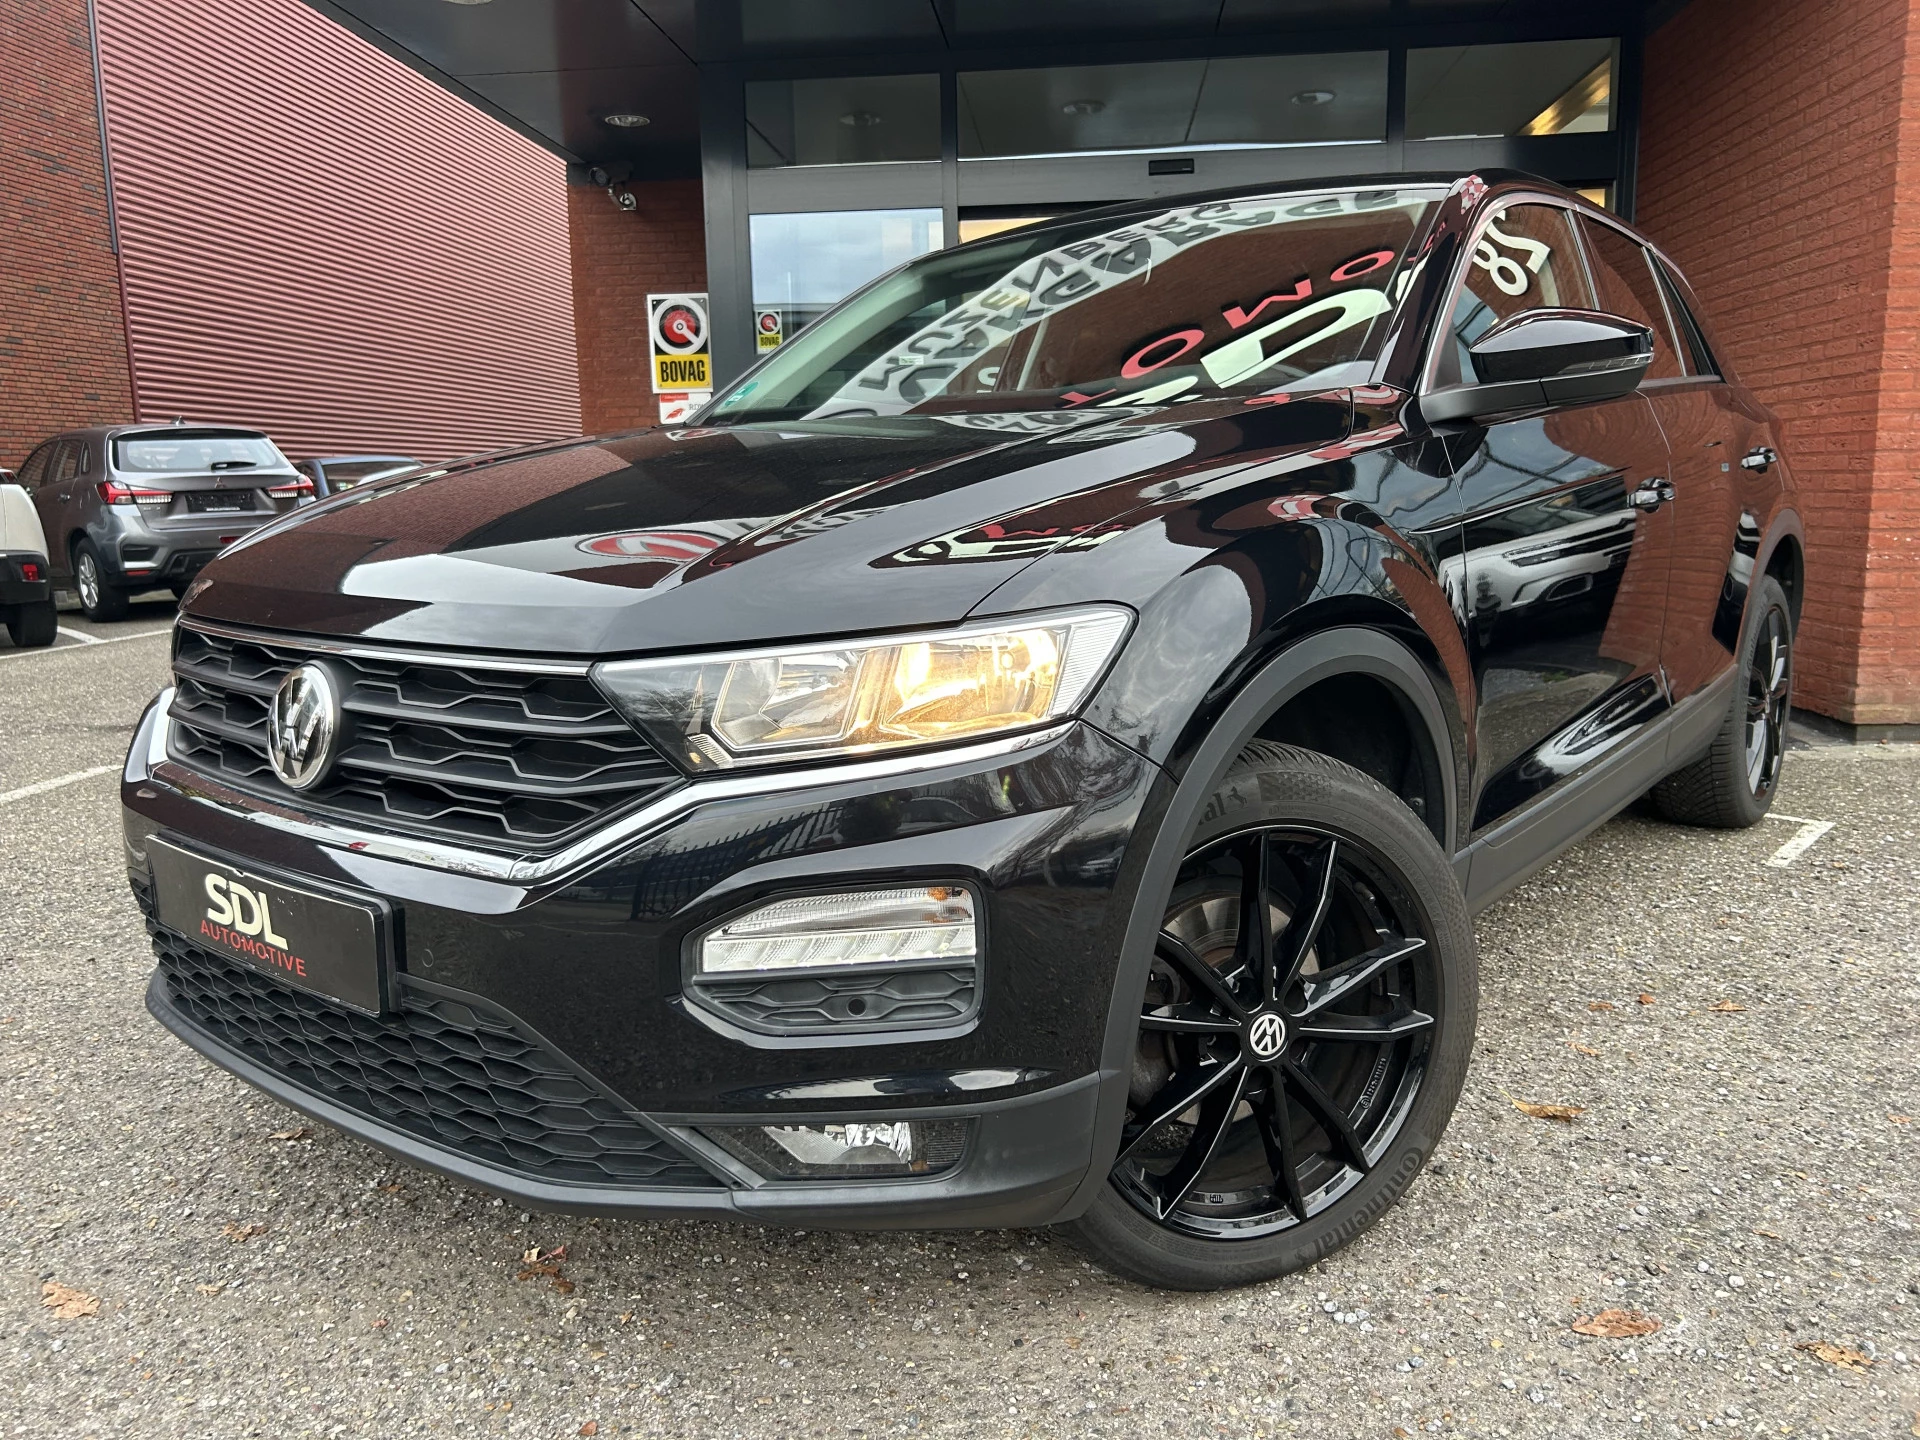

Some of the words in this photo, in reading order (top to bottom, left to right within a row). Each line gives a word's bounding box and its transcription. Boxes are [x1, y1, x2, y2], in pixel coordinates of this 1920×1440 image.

[760, 336, 780, 347] BOVAG
[660, 359, 706, 382] BOVAG
[204, 873, 289, 950] SDL
[200, 919, 307, 977] AUTOMOTIVE
